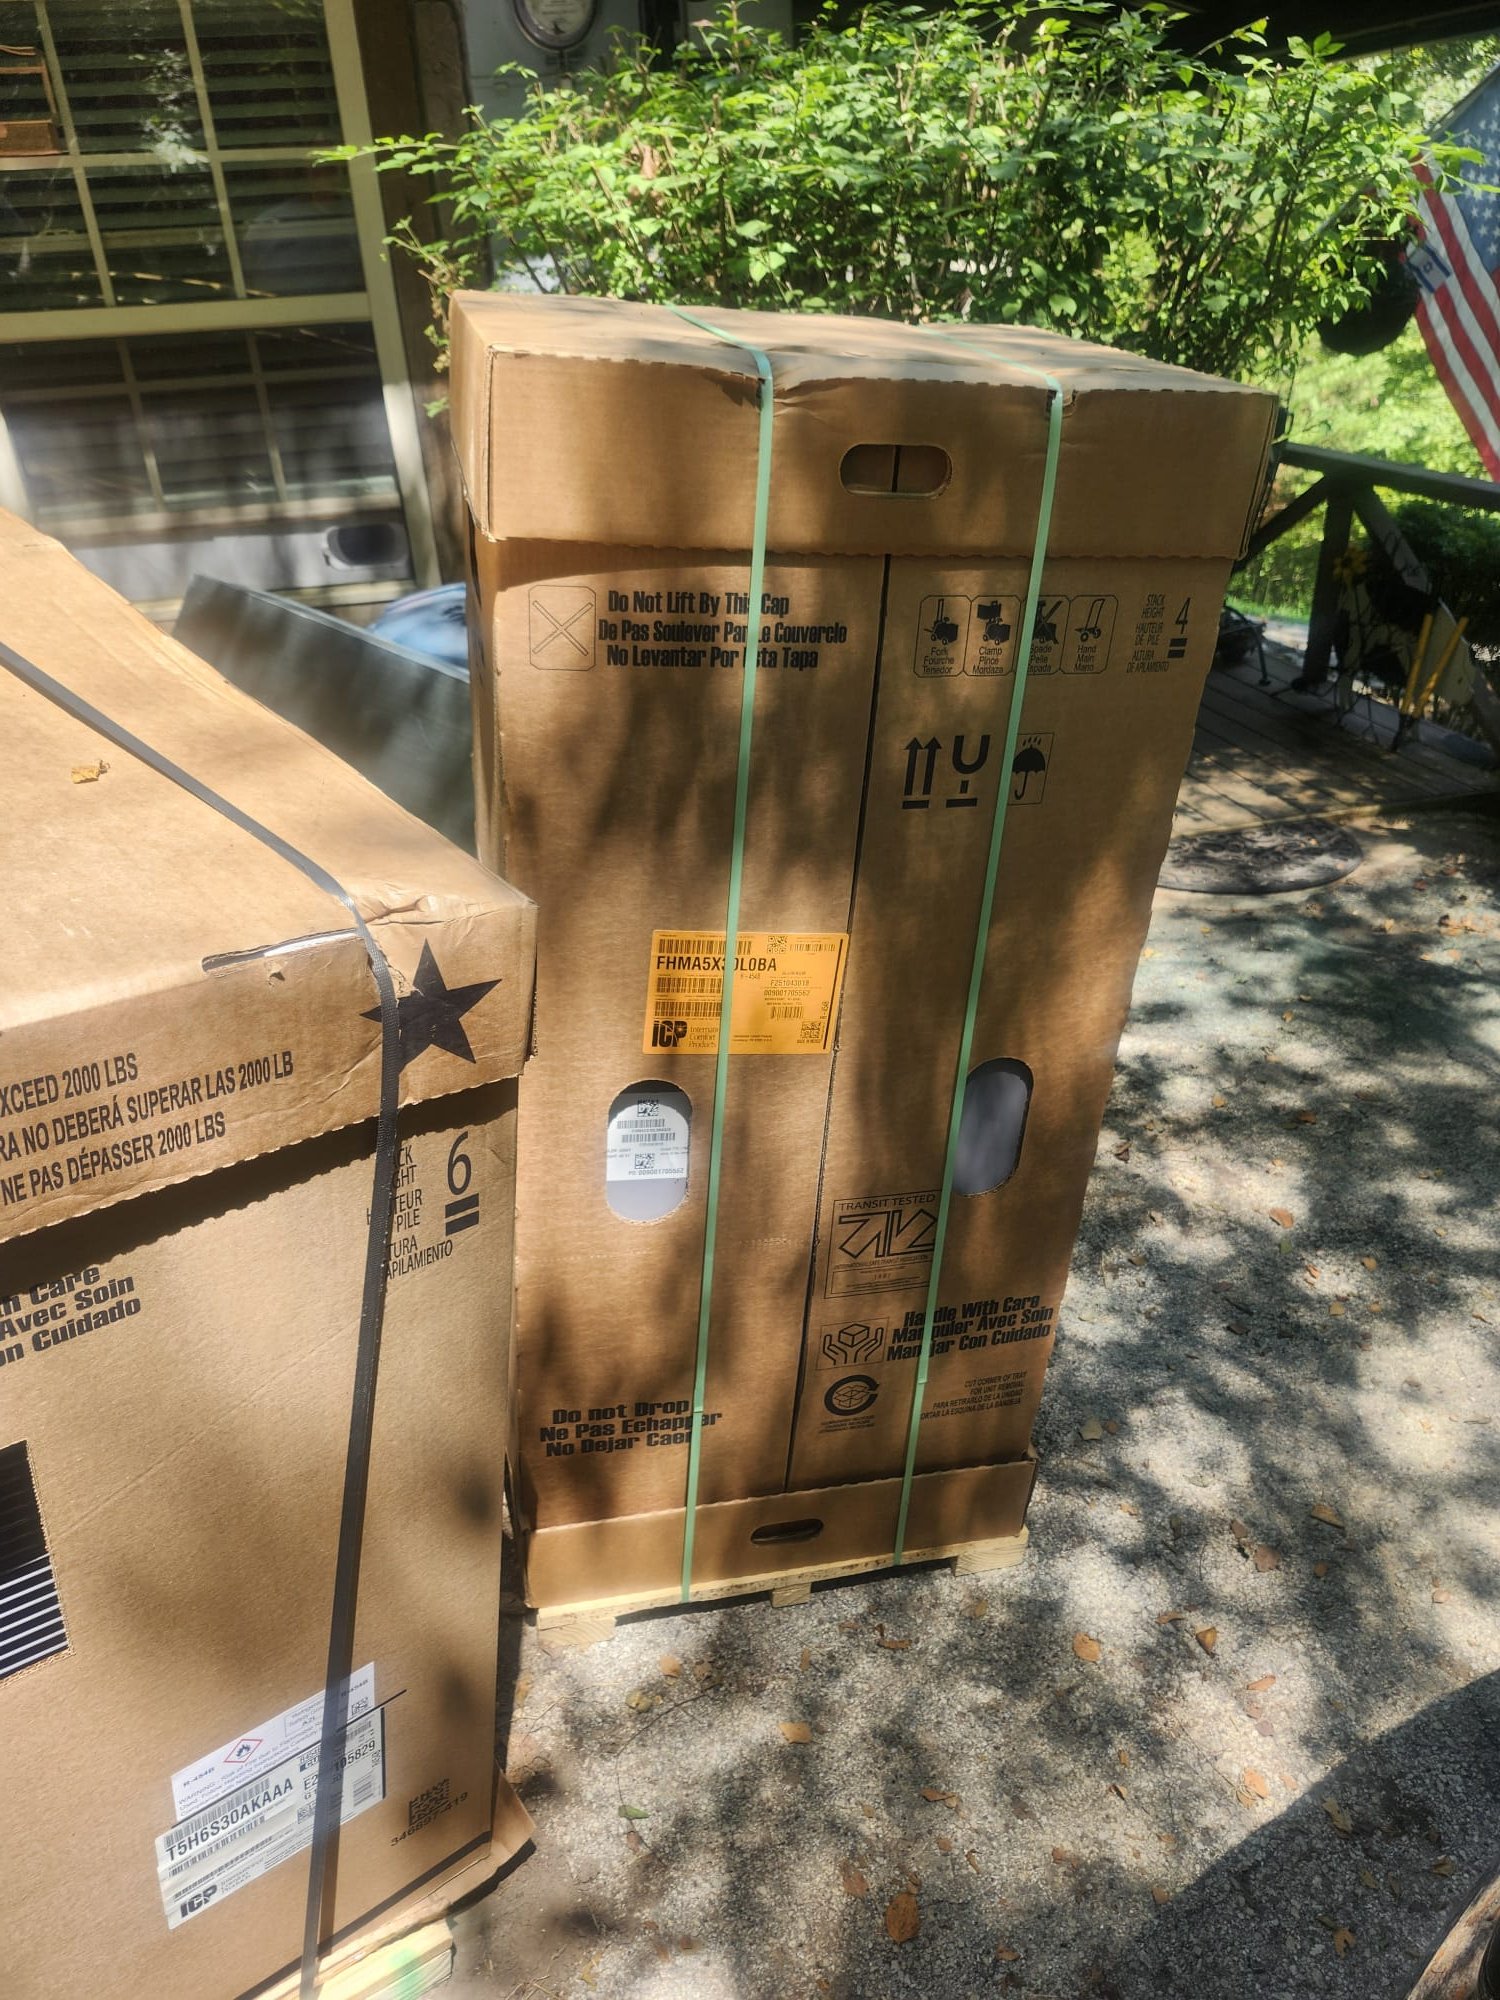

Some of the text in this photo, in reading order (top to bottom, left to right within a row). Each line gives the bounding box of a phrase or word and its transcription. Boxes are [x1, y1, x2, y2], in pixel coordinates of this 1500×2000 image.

[608, 589, 789, 618] Do Not Lift By Thi Cap
[1175, 597, 1191, 634] 4
[598, 619, 620, 641] De
[621, 620, 649, 642] Pas
[723, 621, 748, 643] Par
[607, 645, 628, 666] No
[632, 646, 706, 668] Levantar
[710, 646, 739, 668] Por
[780, 648, 818, 671] Tapa
[978, 647, 1003, 657] Clamp
[62, 1062, 100, 1098] 2000
[103, 1052, 138, 1088] LBS
[22, 1122, 50, 1155] NO
[51, 1095, 124, 1146] DEBERÁ
[127, 1076, 203, 1124] SUPERAR
[205, 1066, 236, 1101] LAS
[238, 1055, 271, 1091] 2000
[273, 1050, 294, 1080] LB
[0, 1110, 226, 1206] NE PAS DÉPASSER 2000 LBS
[447, 1130, 472, 1196] 6
[396, 1208, 421, 1233] PILE
[838, 1193, 937, 1211] TRANSIT TESTED
[29, 1266, 101, 1306] Care
[0, 1302, 67, 1342] Avec
[74, 1276, 135, 1311] Soin
[32, 1298, 141, 1352] Cuidado
[892, 1306, 1053, 1345] Manpuler Avec Soin
[903, 1295, 1040, 1328] Hadle With Care
[886, 1323, 1051, 1362] Manjar Con Cuidado
[552, 1400, 690, 1424] Do not Drop
[539, 1426, 569, 1442] Ne
[575, 1422, 615, 1439] Pas
[546, 1442, 574, 1457] No
[581, 1436, 640, 1454] Dejar
[303, 1740, 376, 1791] E2105829
[165, 1777, 294, 1862] T5H6S30AKAAA
